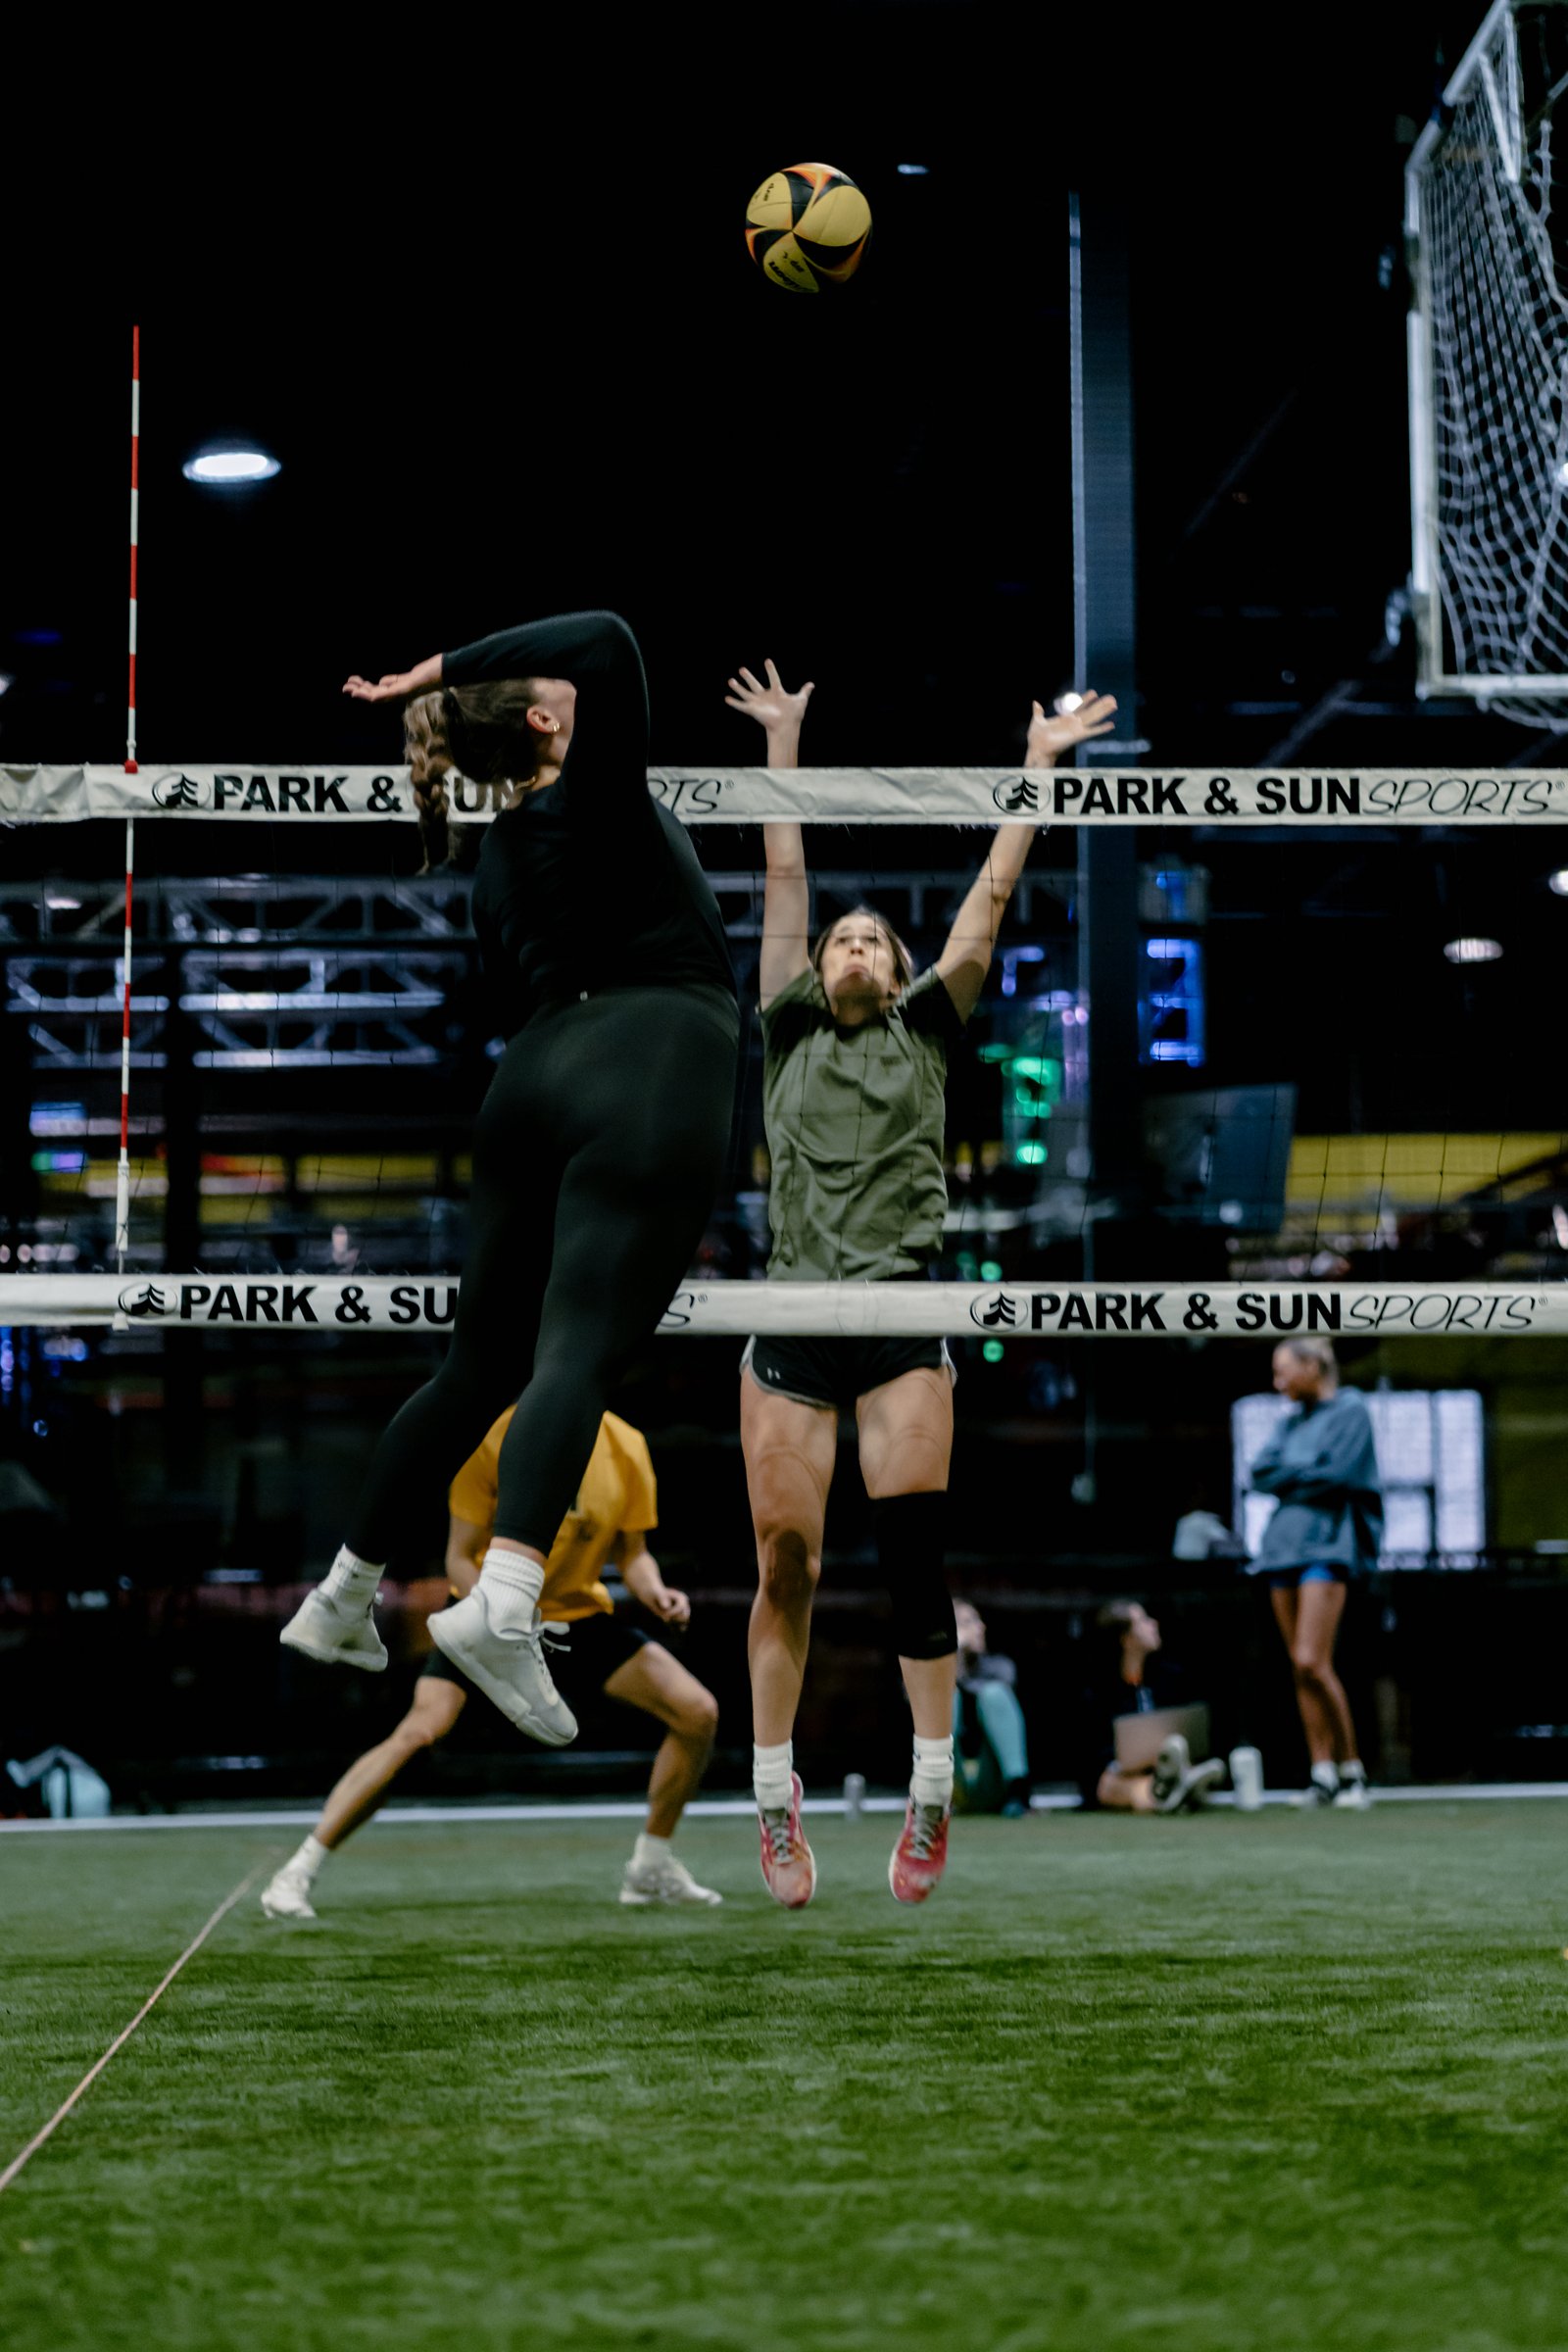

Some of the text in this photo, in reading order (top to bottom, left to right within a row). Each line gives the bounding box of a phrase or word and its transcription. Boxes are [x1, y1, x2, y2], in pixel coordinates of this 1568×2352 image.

[213, 773, 351, 813] PARK
[367, 774, 403, 813] &
[1053, 776, 1553, 815] PARK & SUN SPORTS
[179, 1284, 459, 1325] PARK & SU
[1030, 1292, 1537, 1331] PARK & SUN SPORTS
